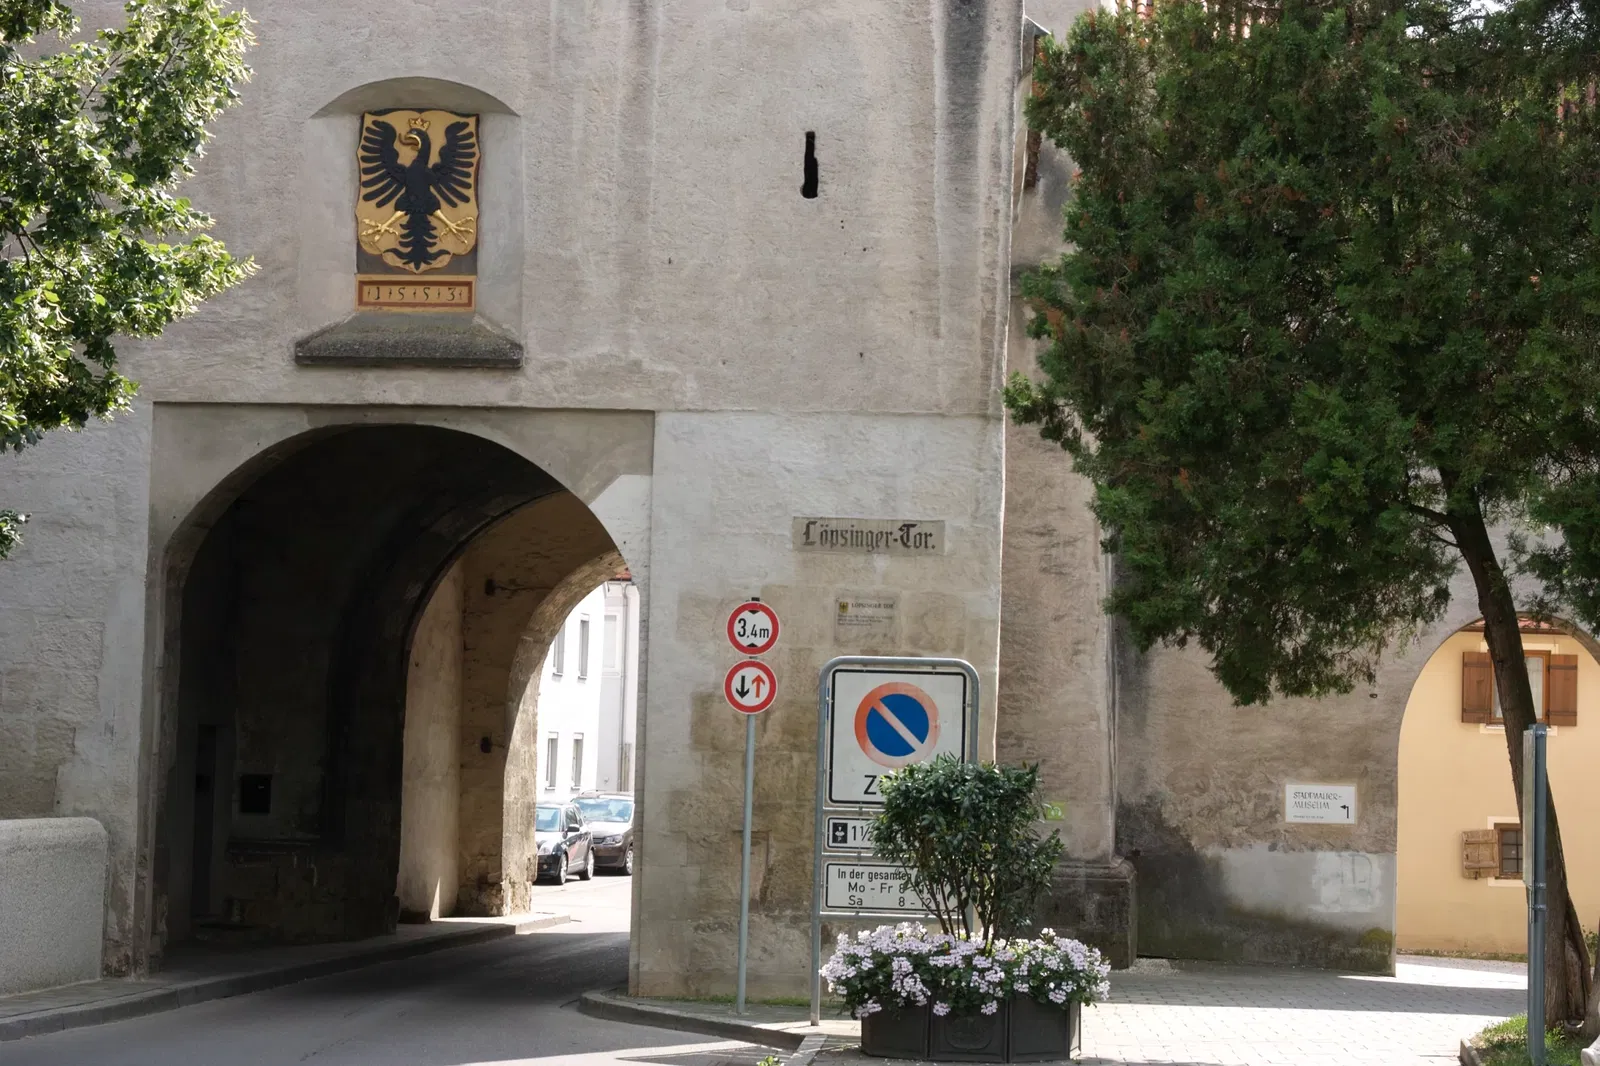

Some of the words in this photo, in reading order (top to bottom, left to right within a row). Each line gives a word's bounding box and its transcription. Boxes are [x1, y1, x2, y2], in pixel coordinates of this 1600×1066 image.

[803, 520, 935, 552] Löpsinger-Tor.
[1292, 801, 1330, 810] MUSEUM
[837, 868, 847, 879] In
[849, 868, 865, 880] der
[848, 881, 866, 893] Mo
[880, 882, 894, 894] Fr
[848, 894, 863, 906] Sa
[899, 896, 906, 907] 8
